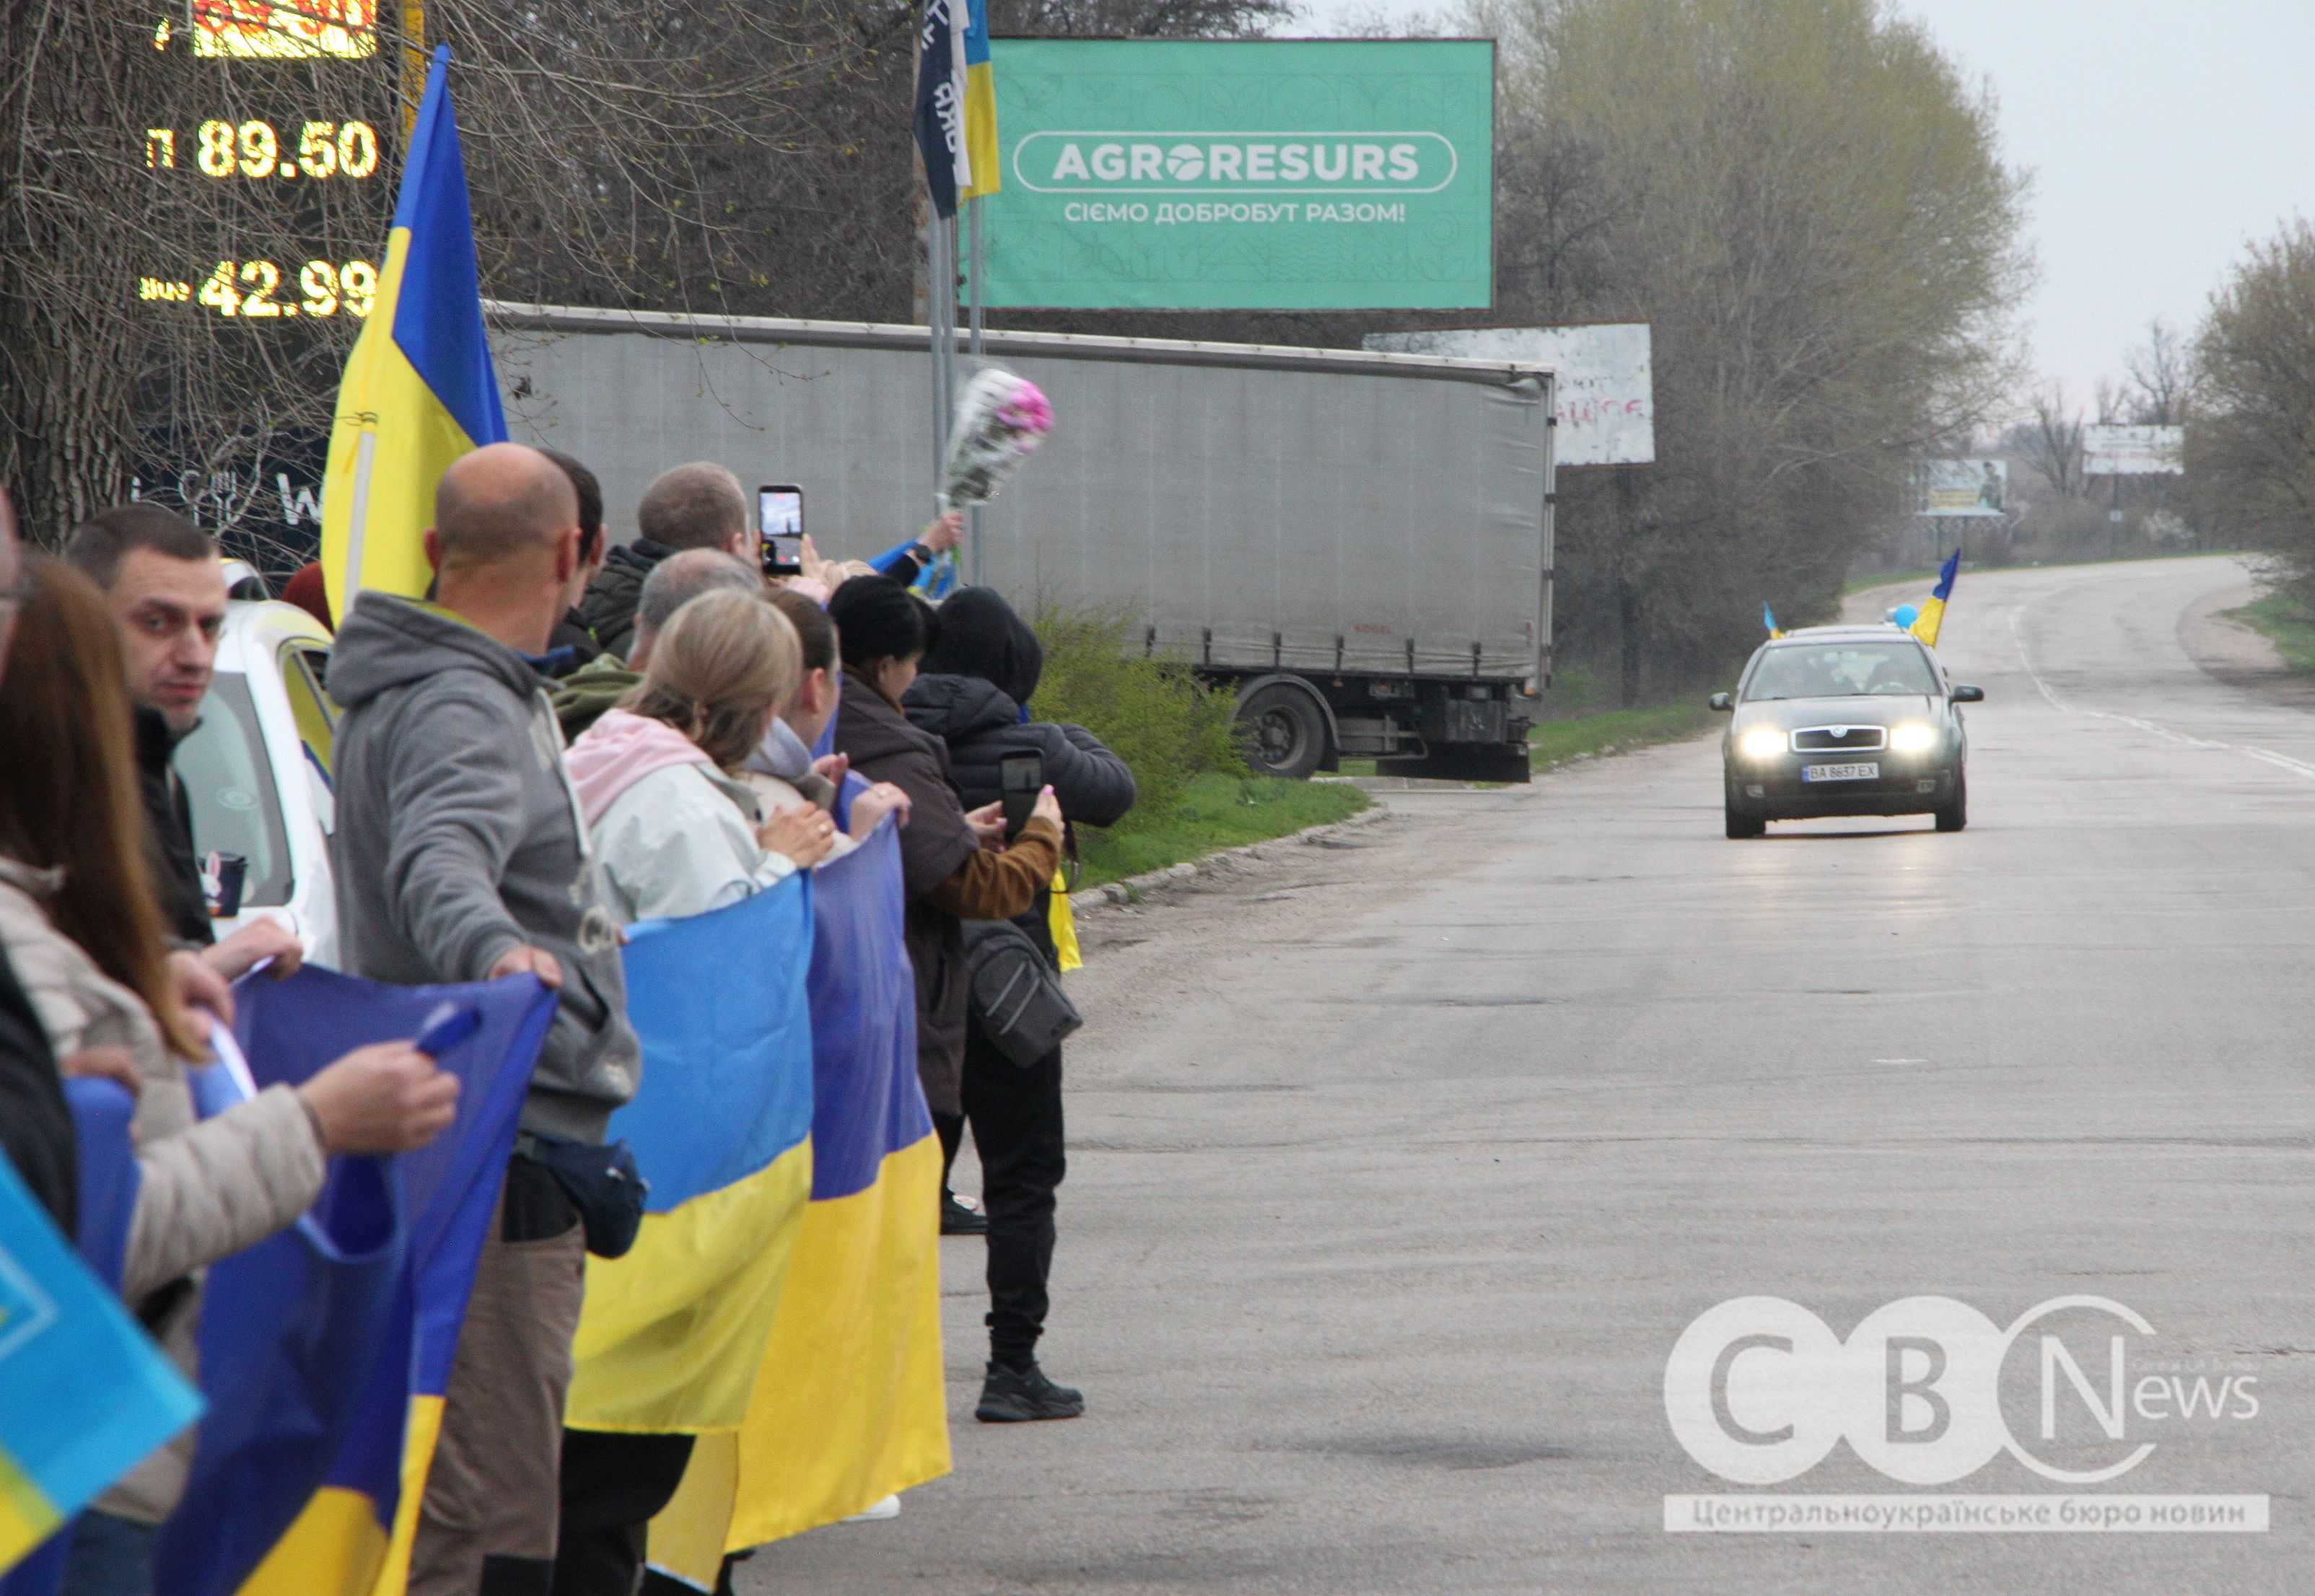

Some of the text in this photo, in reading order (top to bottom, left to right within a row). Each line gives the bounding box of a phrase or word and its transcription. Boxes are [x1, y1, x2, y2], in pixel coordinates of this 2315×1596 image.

[198, 120, 377, 177] 89.50
[1064, 203, 1406, 224] СІЄМО ДОБРОБУТ РАЗОМ!
[199, 260, 378, 317] 42.99
